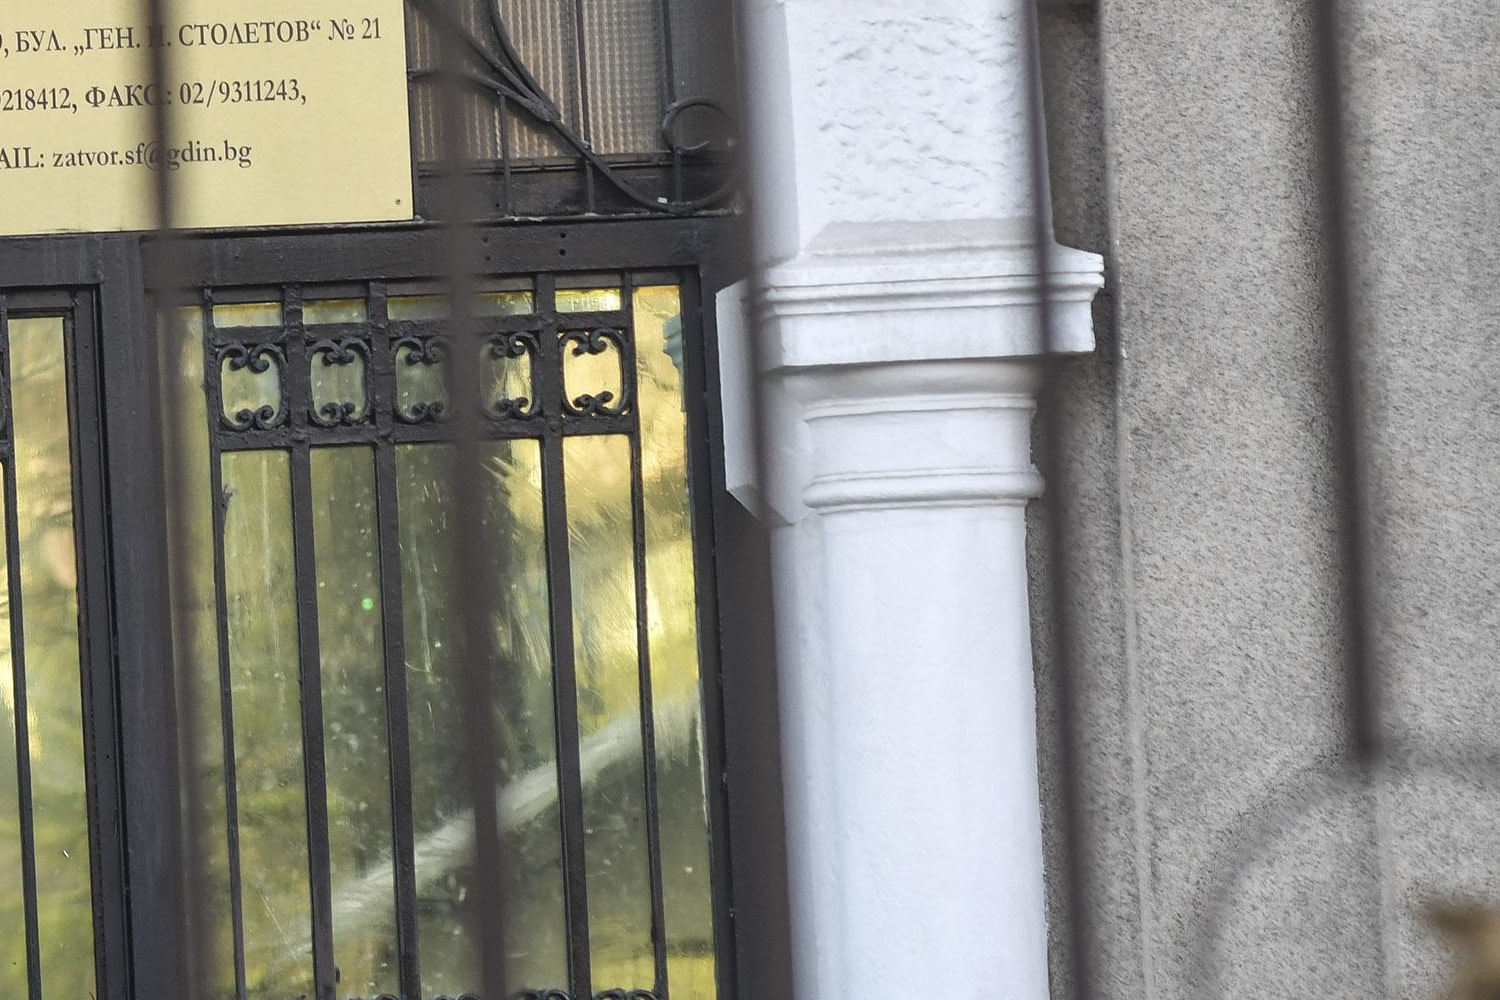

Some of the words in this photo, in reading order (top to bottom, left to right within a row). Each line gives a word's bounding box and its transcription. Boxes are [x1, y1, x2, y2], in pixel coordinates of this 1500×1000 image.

[15, 29, 67, 53] БУЛ.
[73, 26, 141, 56] „ГЕН.
[328, 19, 355, 41] №
[361, 17, 382, 40] 21
[179, 78, 307, 109] 02/9311243,
[52, 139, 253, 171] zatvor.sf@gdin.bg
